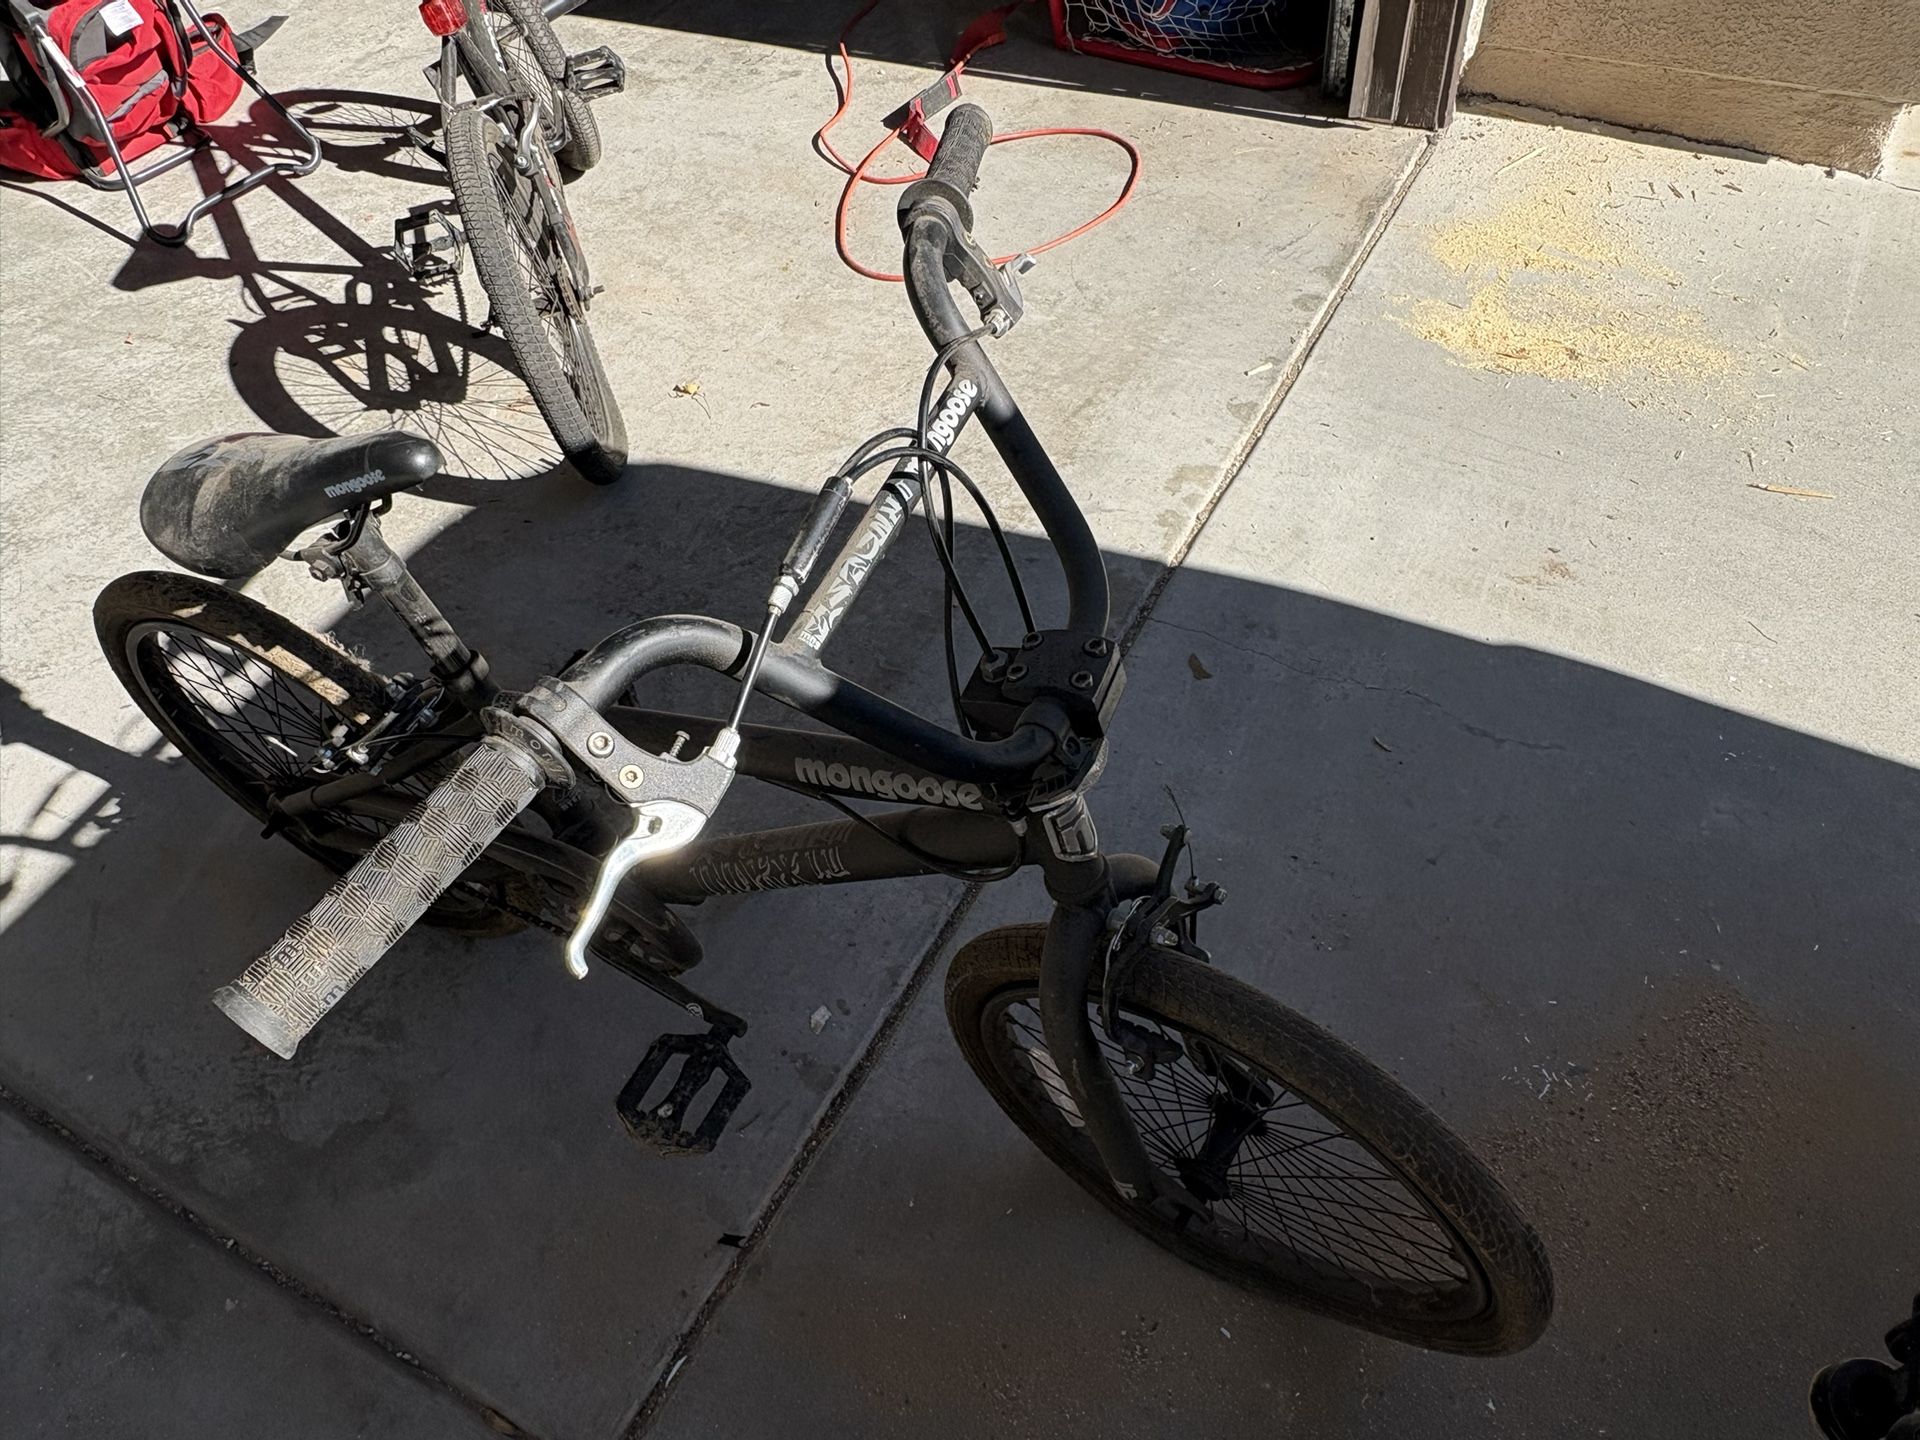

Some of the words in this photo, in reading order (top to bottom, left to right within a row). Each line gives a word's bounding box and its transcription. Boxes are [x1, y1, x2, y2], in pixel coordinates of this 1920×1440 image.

[904, 379, 978, 474] ngoose
[324, 469, 386, 498] mongoose
[795, 757, 984, 811] mongoose
